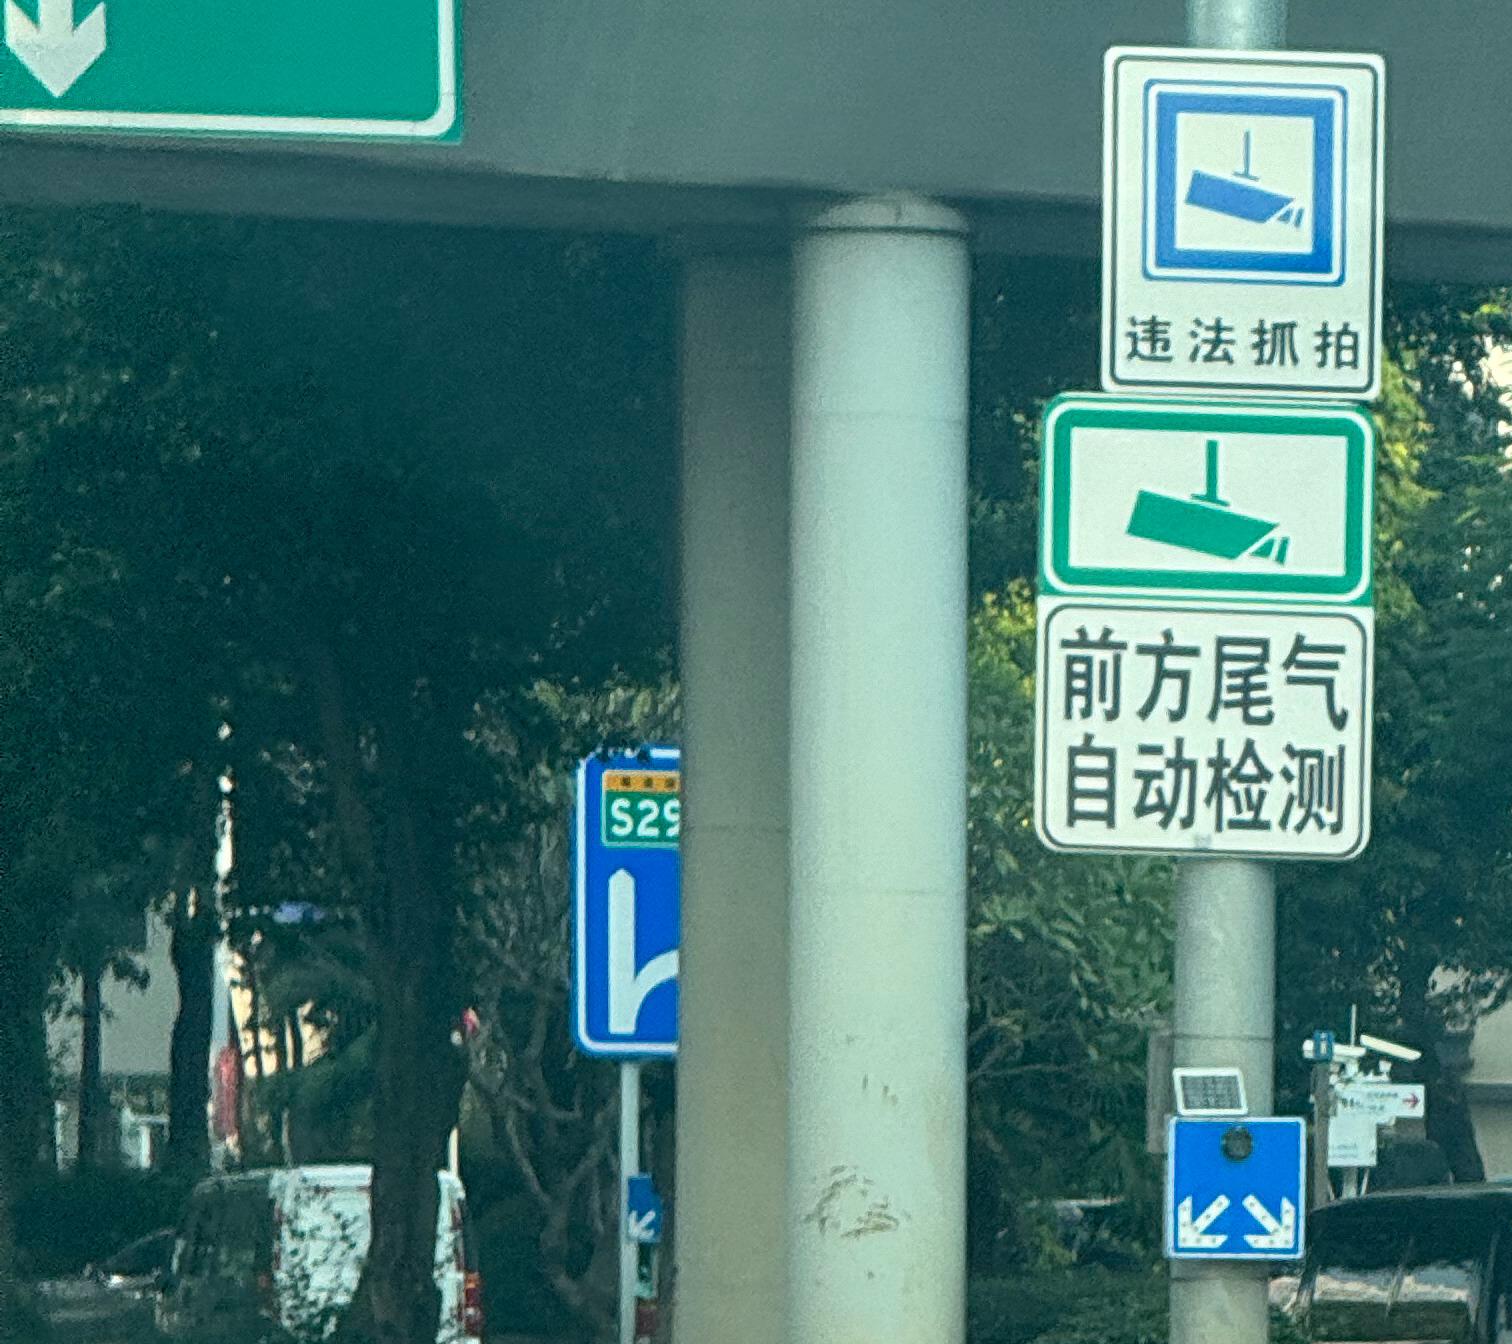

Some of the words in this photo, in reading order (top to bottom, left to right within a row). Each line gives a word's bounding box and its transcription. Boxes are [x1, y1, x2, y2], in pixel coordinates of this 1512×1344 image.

[1126, 315, 1359, 370] 违法抓拍
[1060, 625, 1349, 731] 前方尾气
[1066, 732, 1346, 835] 自动检测
